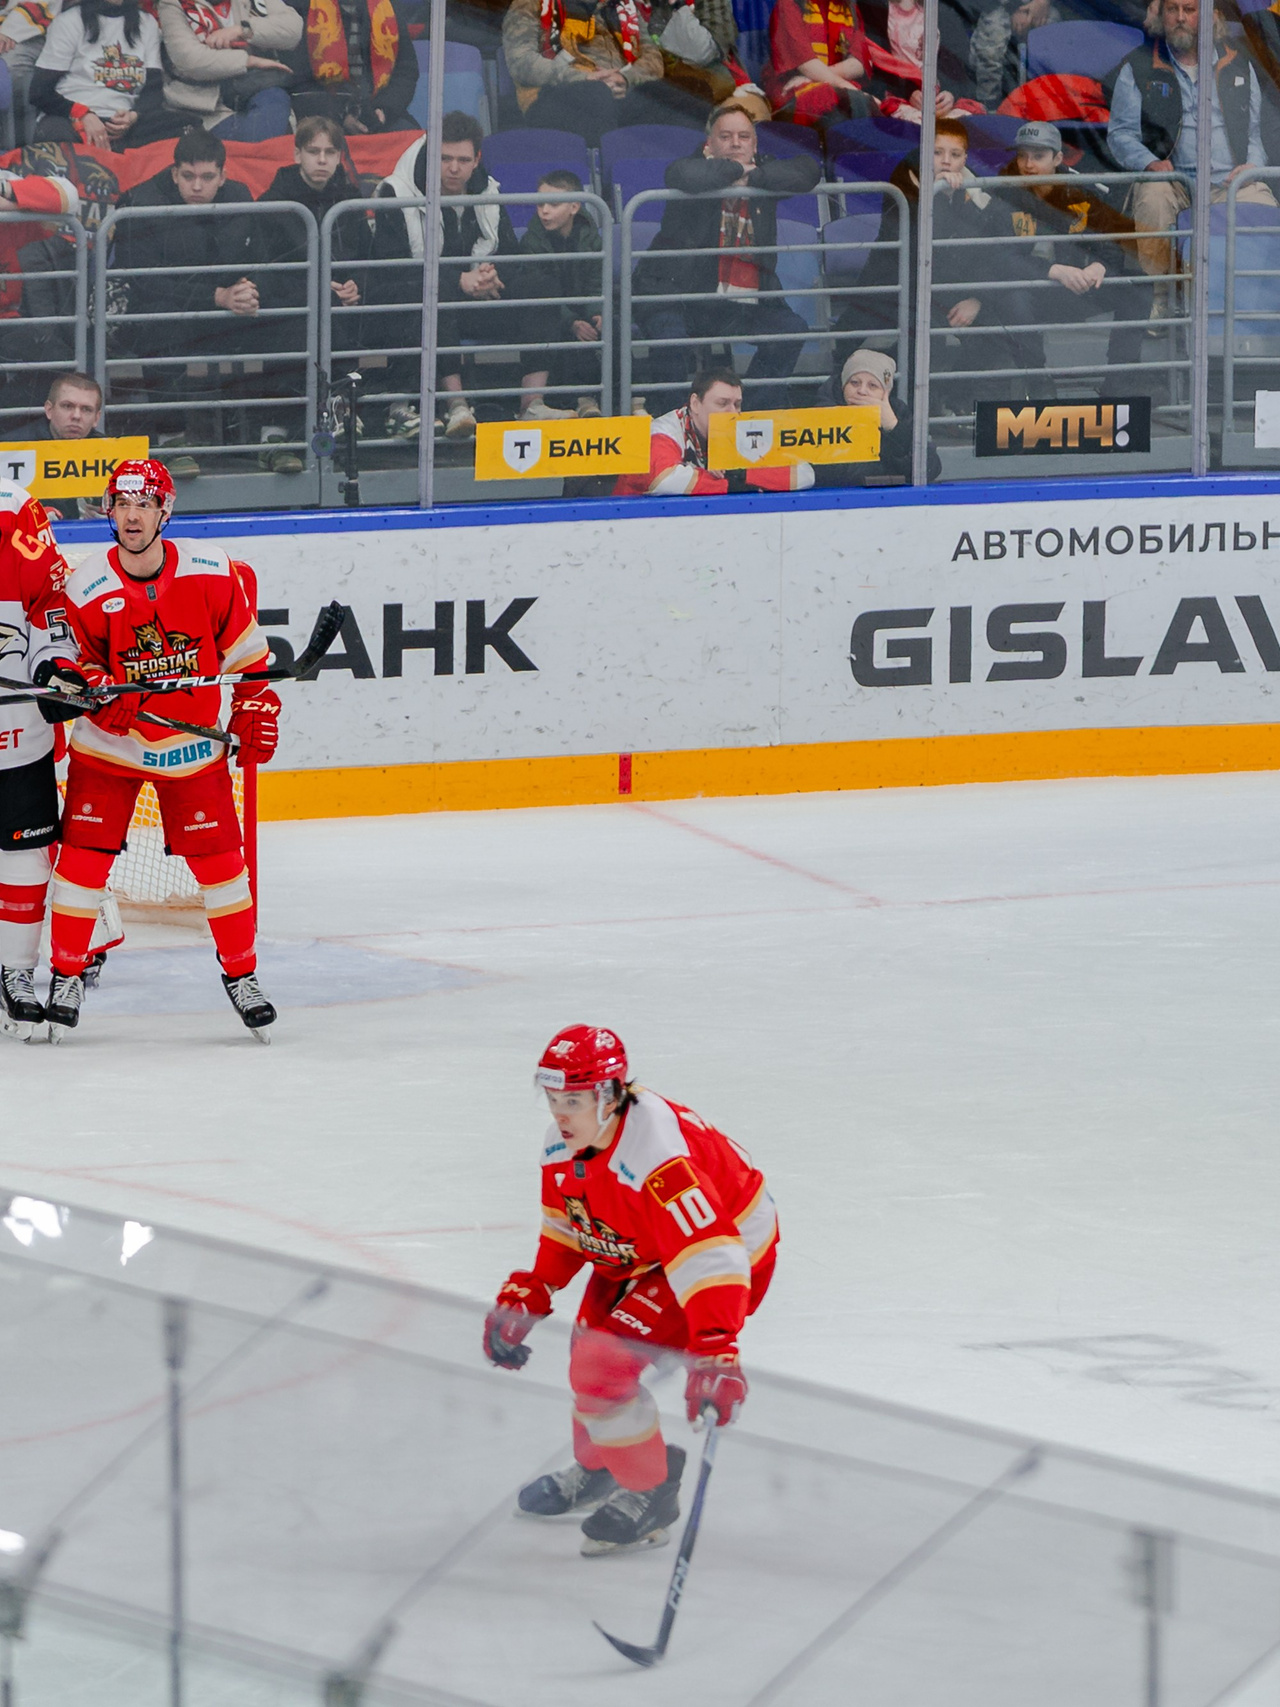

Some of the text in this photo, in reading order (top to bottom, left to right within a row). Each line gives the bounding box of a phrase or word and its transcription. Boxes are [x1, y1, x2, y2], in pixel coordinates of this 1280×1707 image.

[779, 426, 853, 447] БАНК
[996, 405, 1131, 449] МАТЧ!
[549, 437, 623, 458] БАНК
[43, 459, 119, 479] БАНК
[257, 597, 540, 682] БАНК
[122, 648, 200, 684] REDSTAR
[154, 673, 244, 690] TRUE
[232, 700, 279, 715] CCM
[143, 740, 213, 767] SIBUR
[665, 1187, 717, 1237] 10
[611, 1309, 652, 1336] CCM
